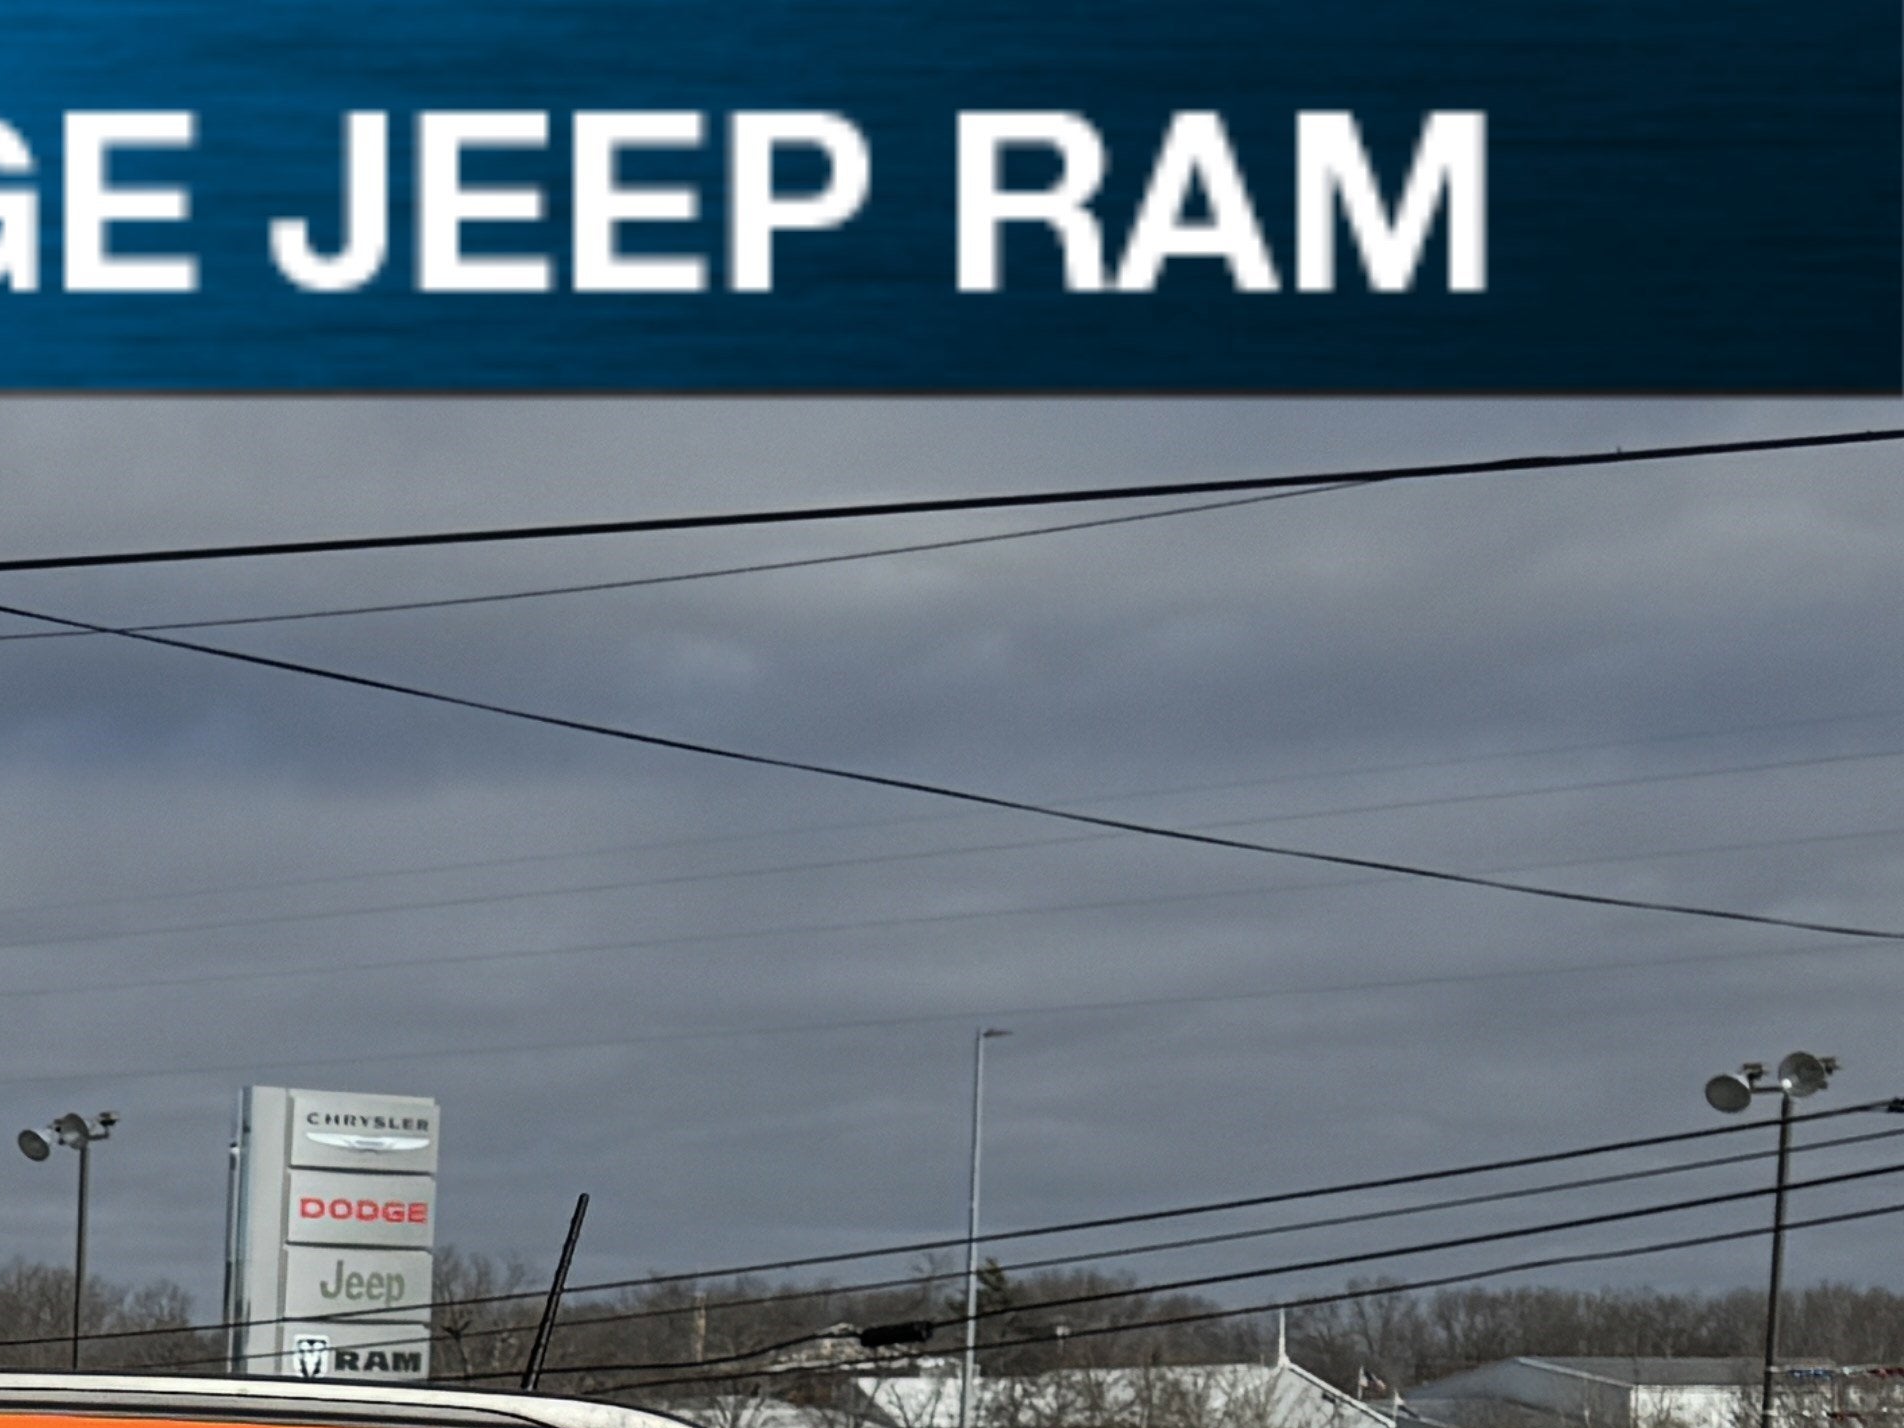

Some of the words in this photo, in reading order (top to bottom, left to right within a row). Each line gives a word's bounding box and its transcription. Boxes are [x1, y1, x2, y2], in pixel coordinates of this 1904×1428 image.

[306, 1112, 429, 1131] CHRYSLER
[299, 1197, 428, 1223] DODGE
[320, 1259, 405, 1305] Jeep
[334, 1350, 421, 1372] RAM
